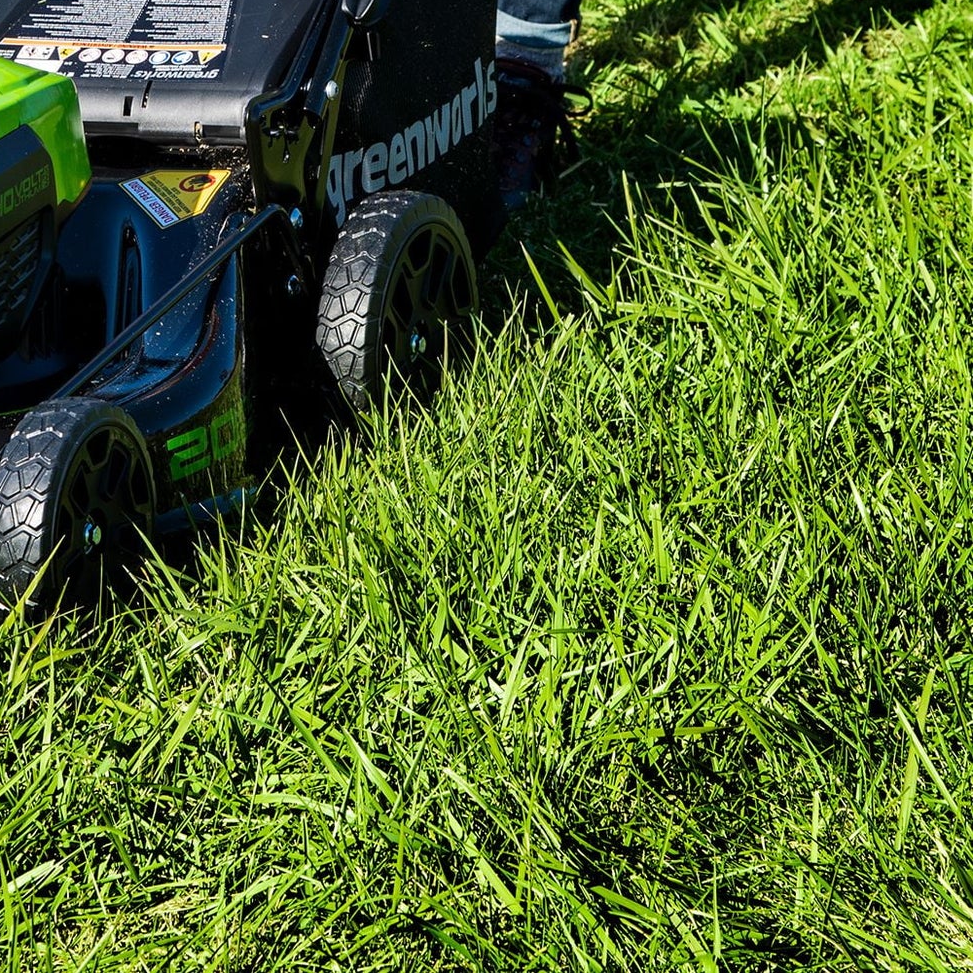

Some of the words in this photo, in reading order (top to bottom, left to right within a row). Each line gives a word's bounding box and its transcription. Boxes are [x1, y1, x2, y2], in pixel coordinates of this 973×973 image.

[133, 69, 219, 79] greenworks
[327, 57, 498, 227] greenworks
[128, 181, 151, 202] PELIGRO
[149, 200, 174, 224] DANGER
